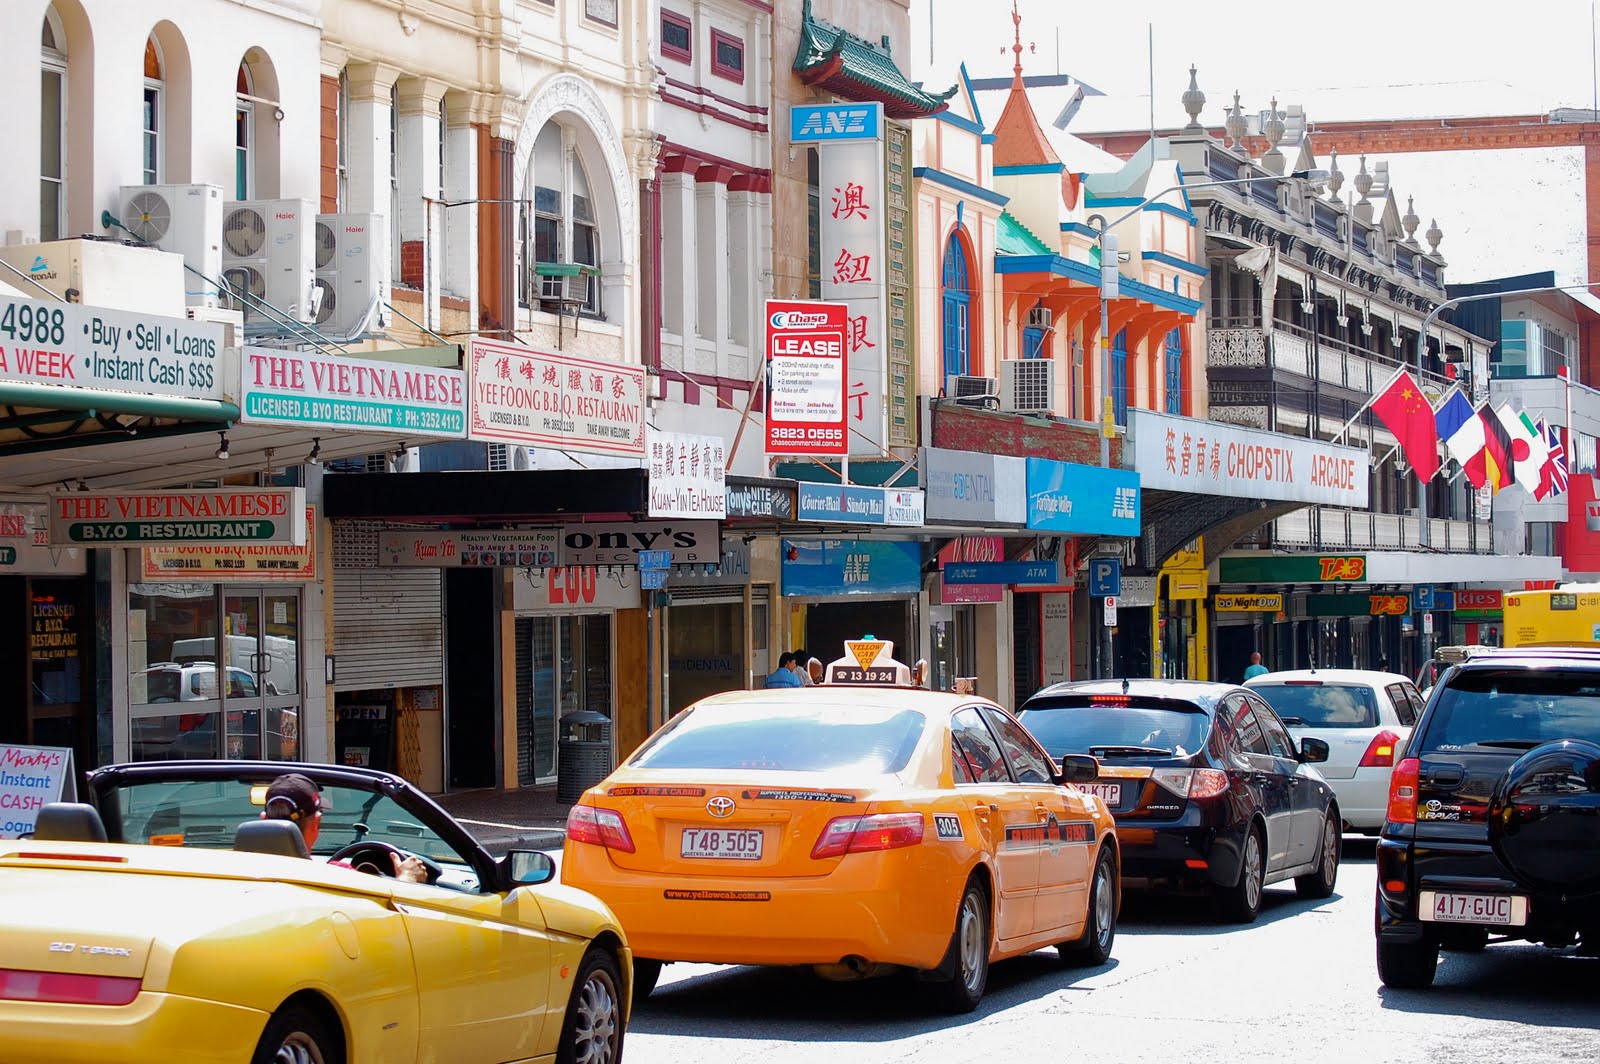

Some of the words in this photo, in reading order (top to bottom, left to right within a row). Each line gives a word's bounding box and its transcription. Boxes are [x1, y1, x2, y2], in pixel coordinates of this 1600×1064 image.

[800, 110, 868, 134] ANZ
[345, 226, 365, 234] Haier
[1, 303, 65, 345] 4988
[789, 313, 826, 322] Chase
[92, 318, 121, 353] Buy
[135, 324, 161, 352] Sell
[174, 329, 215, 359] Loans
[774, 339, 840, 357] LEASE
[15, 348, 75, 379] WEEK
[93, 351, 144, 382] Instant
[149, 357, 184, 386] Cash
[189, 360, 214, 392] $$$
[250, 355, 305, 389] THE
[310, 361, 463, 406] VIETNAMESE
[479, 382, 498, 405] YEE
[500, 385, 541, 411] FOONG
[577, 396, 639, 425] RESTAURANT
[251, 397, 300, 418] LICENSED
[303, 402, 311, 418] &
[313, 402, 332, 420] BYO
[334, 404, 393, 425] RESTAURANT
[405, 411, 419, 427] PH:
[421, 411, 440, 429] 3252
[441, 413, 461, 430] 4112
[490, 411, 513, 425] LICENSED
[587, 423, 597, 435] TAKE
[598, 425, 609, 437] AWAY
[609, 426, 630, 439] WELCOME
[771, 428, 805, 438] 3823
[808, 429, 842, 439] 0555
[771, 439, 842, 448] chasecommercial.com.au
[1227, 442, 1293, 483] CHOPSTIX
[1311, 453, 1354, 490] ARCADE
[751, 487, 771, 501] NITE
[902, 493, 912, 506] THE
[57, 497, 110, 520] THE
[116, 494, 287, 518] VIETNAMESE
[751, 501, 772, 515] CLUB
[847, 496, 870, 516] Sunday
[869, 499, 883, 514] Mail
[888, 505, 921, 522] AUSTRALIAN
[1058, 494, 1072, 518] Valley
[0, 514, 26, 537] ESE
[83, 523, 127, 539] B.Y.O
[140, 523, 260, 538] RESTAURANT
[460, 534, 490, 542] HEALTHY
[492, 534, 534, 542] VEGETARIAN
[536, 533, 555, 542] FOOD
[565, 528, 697, 553] ony's
[414, 540, 438, 560] Kuan
[440, 540, 456, 557] Yin
[487, 544, 506, 552] Away
[163, 559, 184, 568] LICENSED
[257, 560, 267, 568] TAKE
[267, 560, 279, 569] AWAY
[279, 561, 299, 570] WELCOME
[951, 569, 978, 578] ANZ
[1026, 568, 1047, 577] ATM
[1097, 564, 1112, 582] P
[1319, 557, 1365, 581] TAB
[1419, 588, 1430, 600] P
[1458, 592, 1497, 604] kies
[33, 604, 75, 617] LICENSED
[1234, 597, 1280, 609] NightOwl
[1369, 595, 1409, 615] TAB
[36, 620, 42, 632] &
[32, 633, 77, 647] RESTAURANT
[686, 659, 733, 671] DENTAL
[850, 671, 862, 680] 13
[865, 672, 877, 680] 19
[879, 672, 892, 681] 24
[341, 707, 379, 719] OPEN
[0, 748, 61, 770] Monty's
[1, 771, 50, 789] Instant
[1, 793, 43, 810] CASH
[1426, 811, 1460, 820] RAV4
[938, 817, 958, 837] 305
[666, 890, 769, 900] www.yellowcab.com.au
